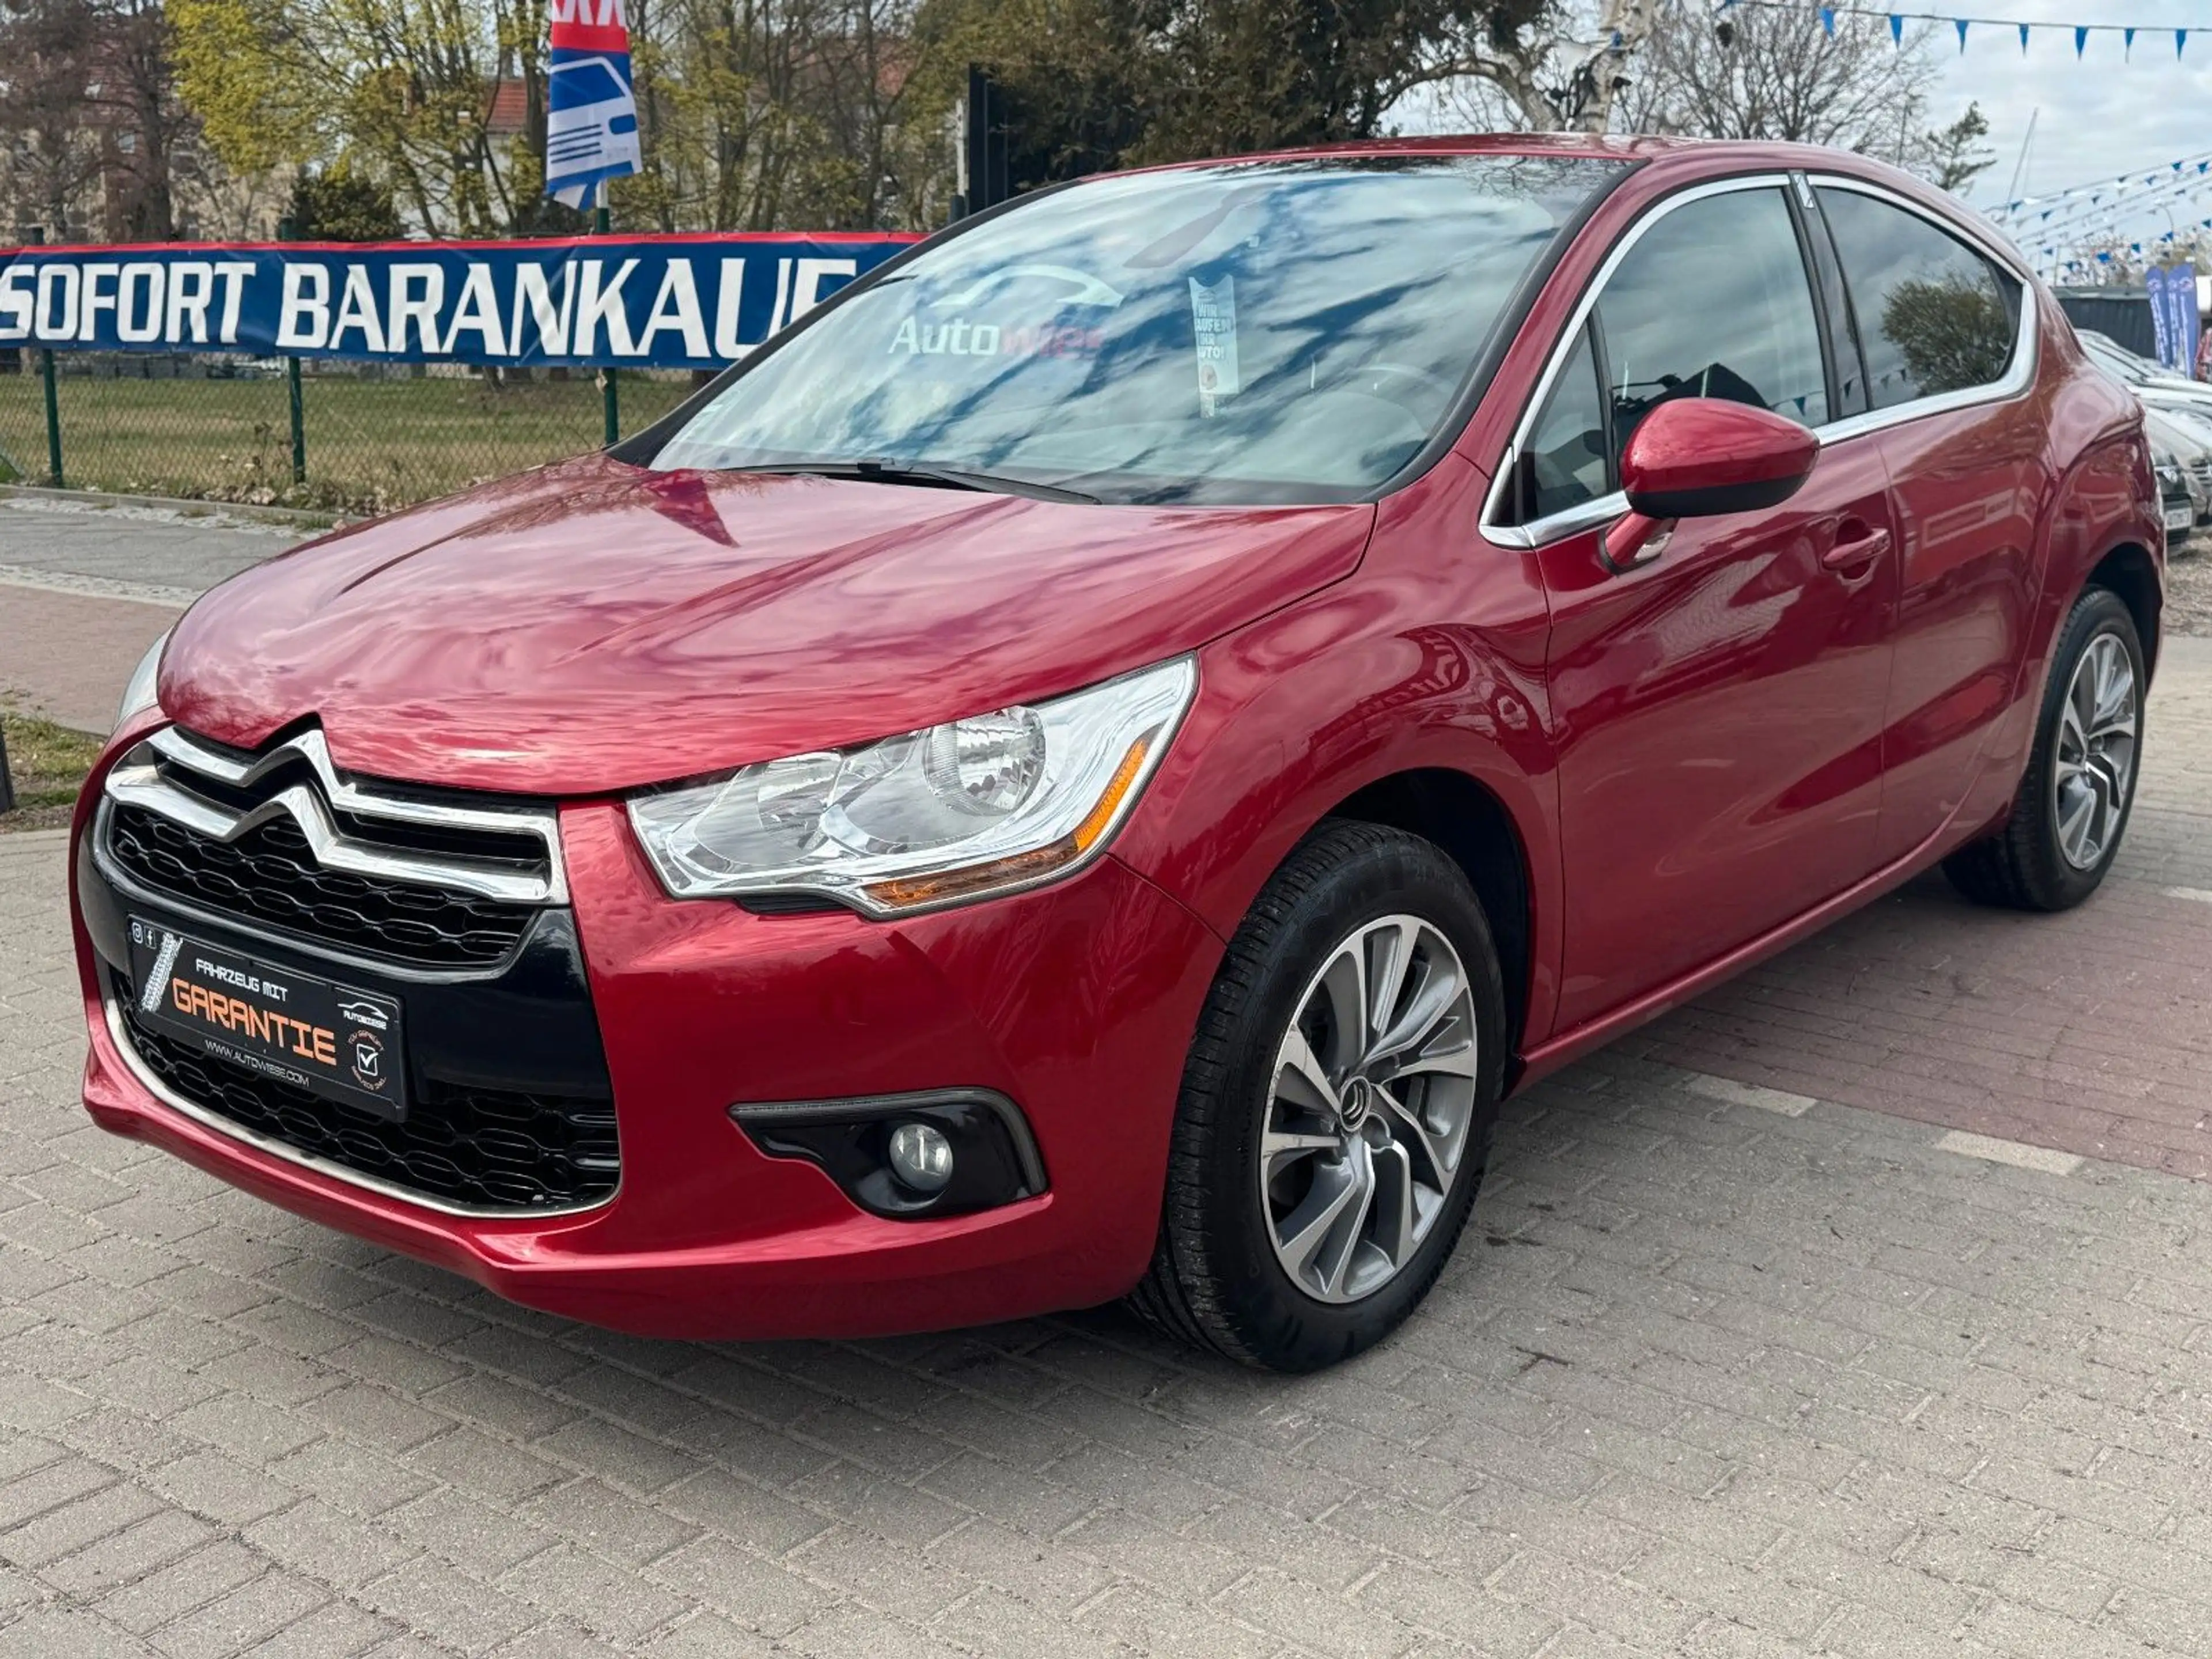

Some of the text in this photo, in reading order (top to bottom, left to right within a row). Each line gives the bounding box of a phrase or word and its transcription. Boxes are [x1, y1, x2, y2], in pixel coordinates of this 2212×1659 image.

[0, 262, 256, 343] SOFORT
[195, 958, 287, 1002] FAHRZEUG MIT
[172, 977, 337, 1066] GARANTIE
